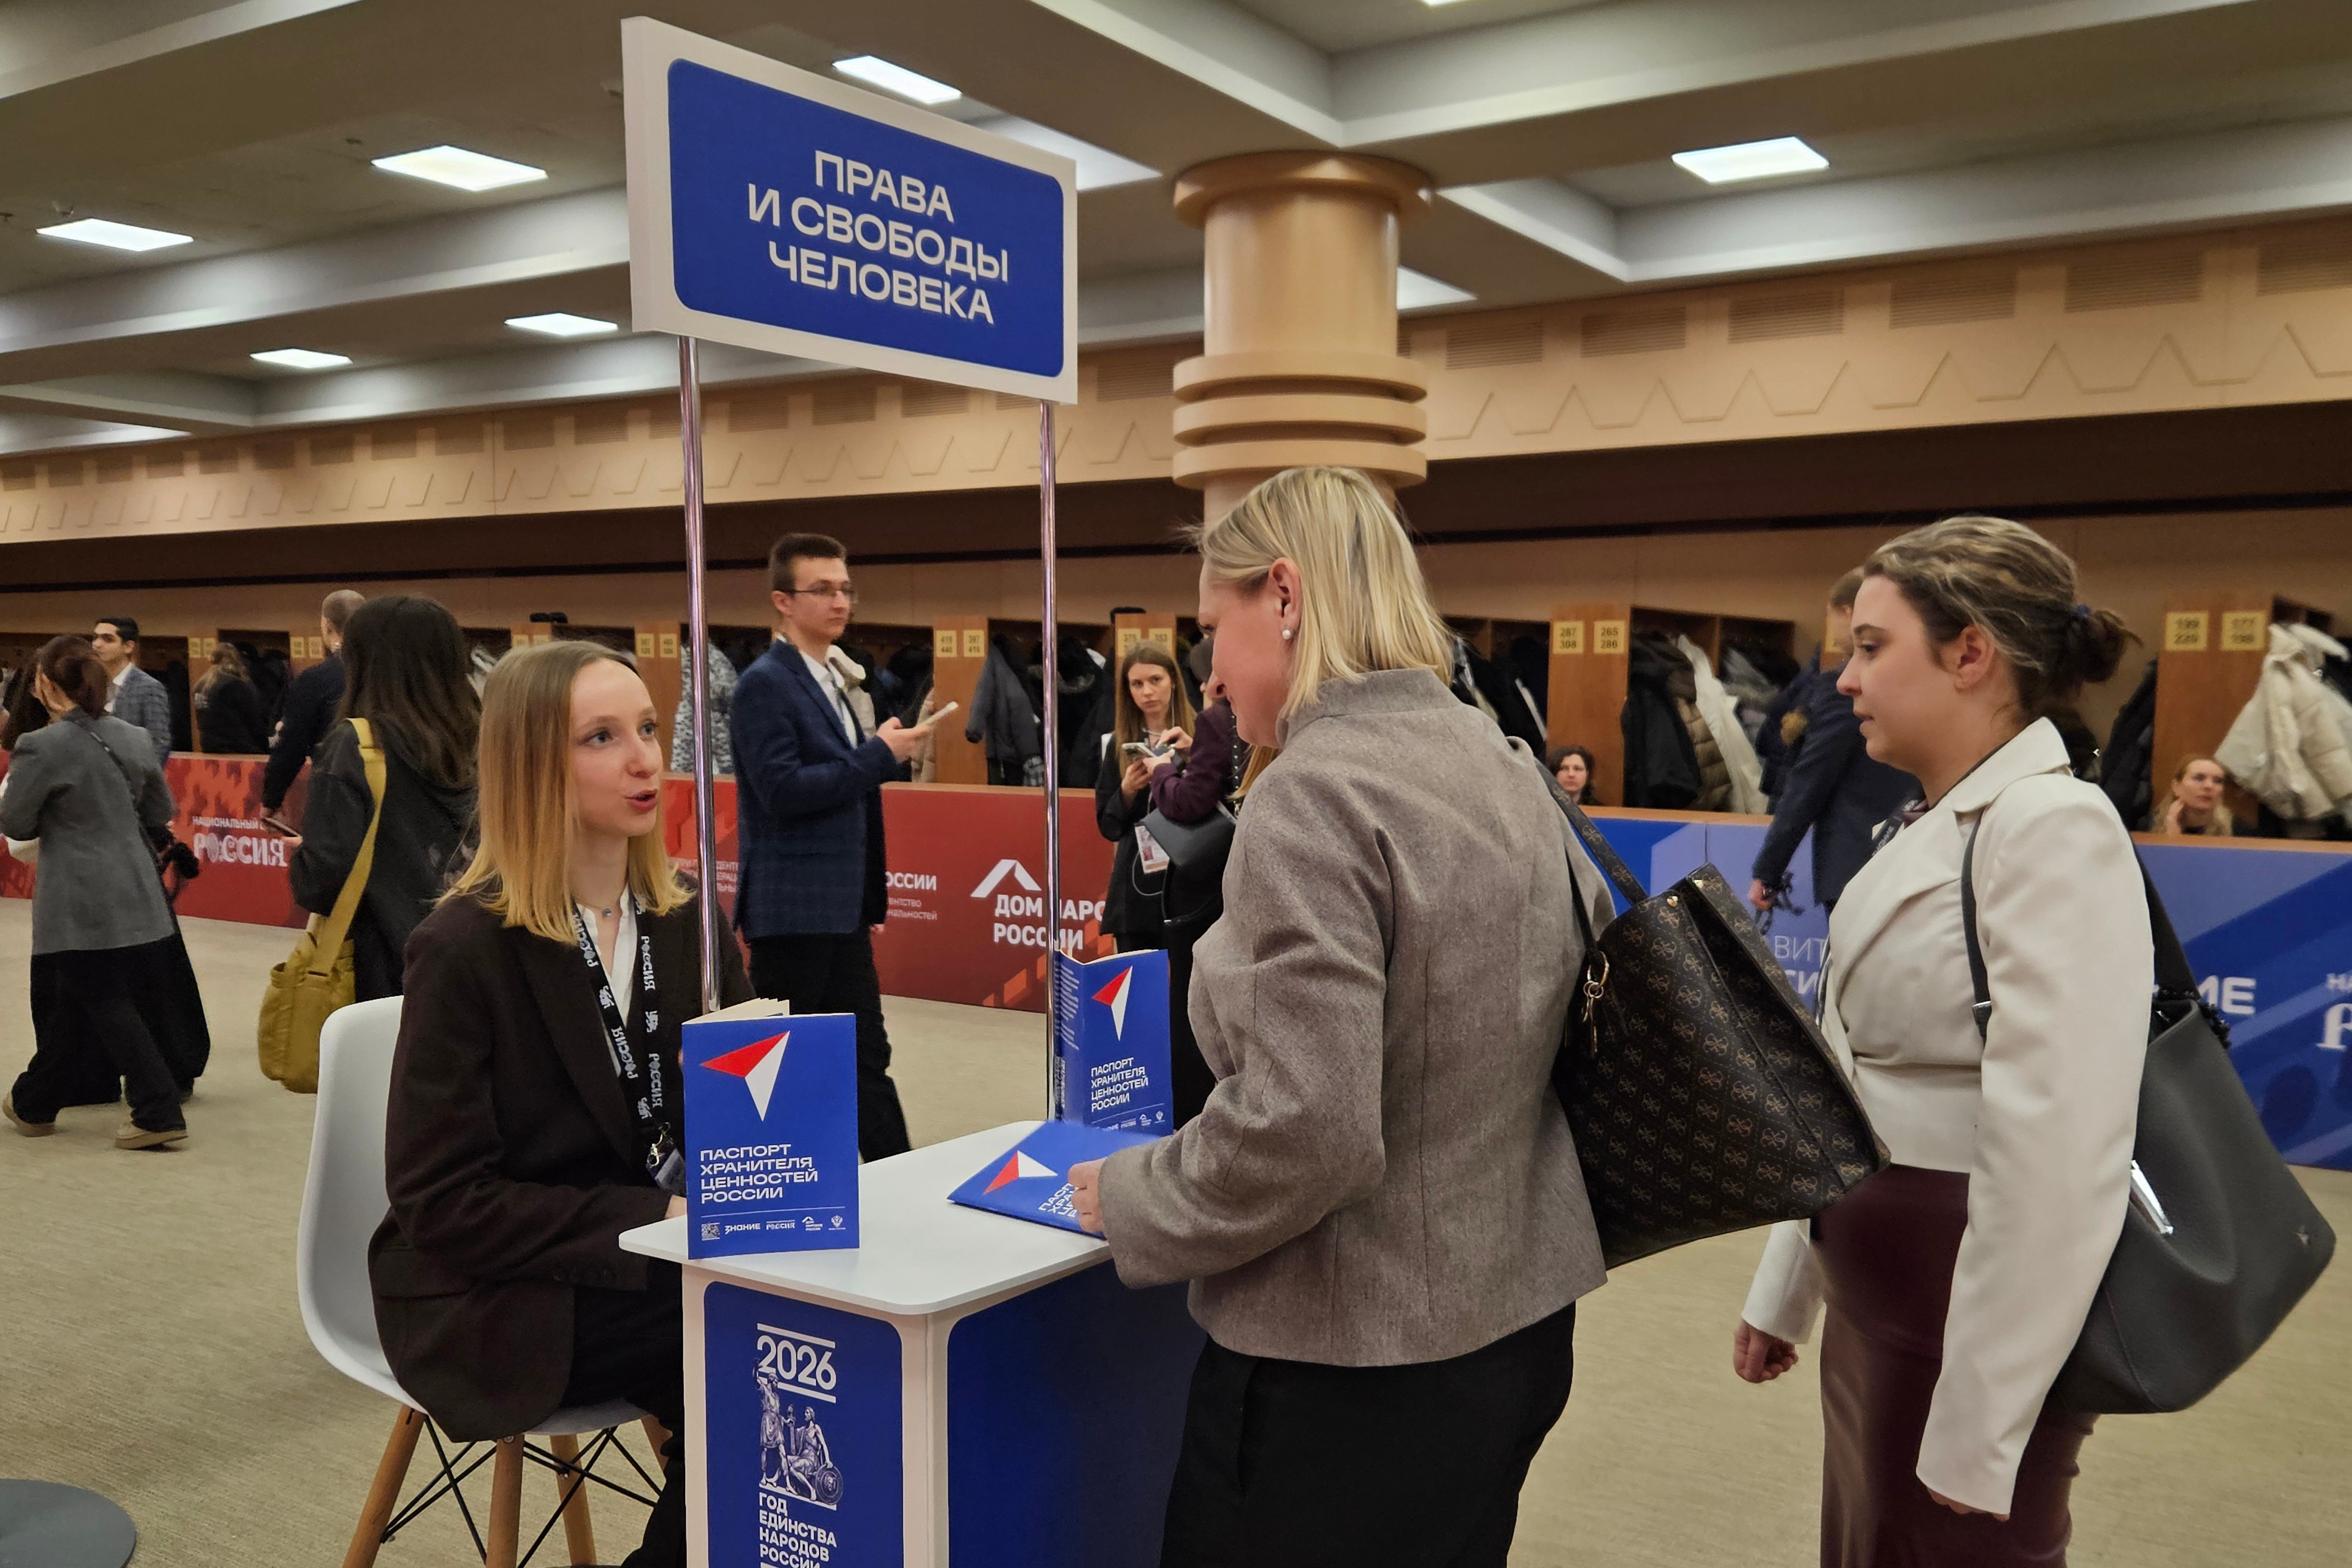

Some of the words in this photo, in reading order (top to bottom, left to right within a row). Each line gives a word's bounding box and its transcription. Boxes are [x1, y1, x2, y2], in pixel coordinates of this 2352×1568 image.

[815, 150, 954, 222] ПРАВА
[748, 183, 780, 227] И
[791, 197, 1009, 283] СВОБОДЫ
[769, 241, 994, 325] ЧЕЛОВЕКА
[1560, 627, 1577, 637] 287
[1601, 627, 1618, 636] 265
[1559, 640, 1577, 649] 308
[193, 816, 259, 830] НАЦИОНАЛЬНЫЙ
[193, 832, 288, 867] РОССИЯ
[885, 871, 937, 891] ОССИИ
[888, 897, 922, 907] ентство
[994, 894, 1042, 918] ДОМ
[887, 909, 938, 920] нальностей
[640, 935, 656, 991] РОССИЯ
[611, 1025, 639, 1079] РОССИЯ
[1091, 1057, 1134, 1077] ПАСПОРТ
[1091, 1066, 1145, 1089] ХРАНИТЕЛЯ
[648, 1053, 663, 1108] РОССИЯ
[1091, 1075, 1149, 1101] ЦЕННОСТЕЙ
[1091, 1092, 1130, 1113] РОССИИ
[700, 1143, 792, 1161] ПАСПОРТ
[700, 1157, 813, 1176] ХРАНИТЕЛЯ
[701, 1168, 819, 1191] ЦЕННОСТЕЙ
[701, 1186, 783, 1204] РОССИИ
[1038, 1183, 1074, 1211] ПАСП
[756, 1335, 837, 1391] 2026
[759, 1491, 788, 1517] ГОД
[759, 1509, 837, 1548] ЕДИНСТВА
[759, 1526, 830, 1563] НАРОДОВ
[759, 1543, 821, 1568] РОССИИ
